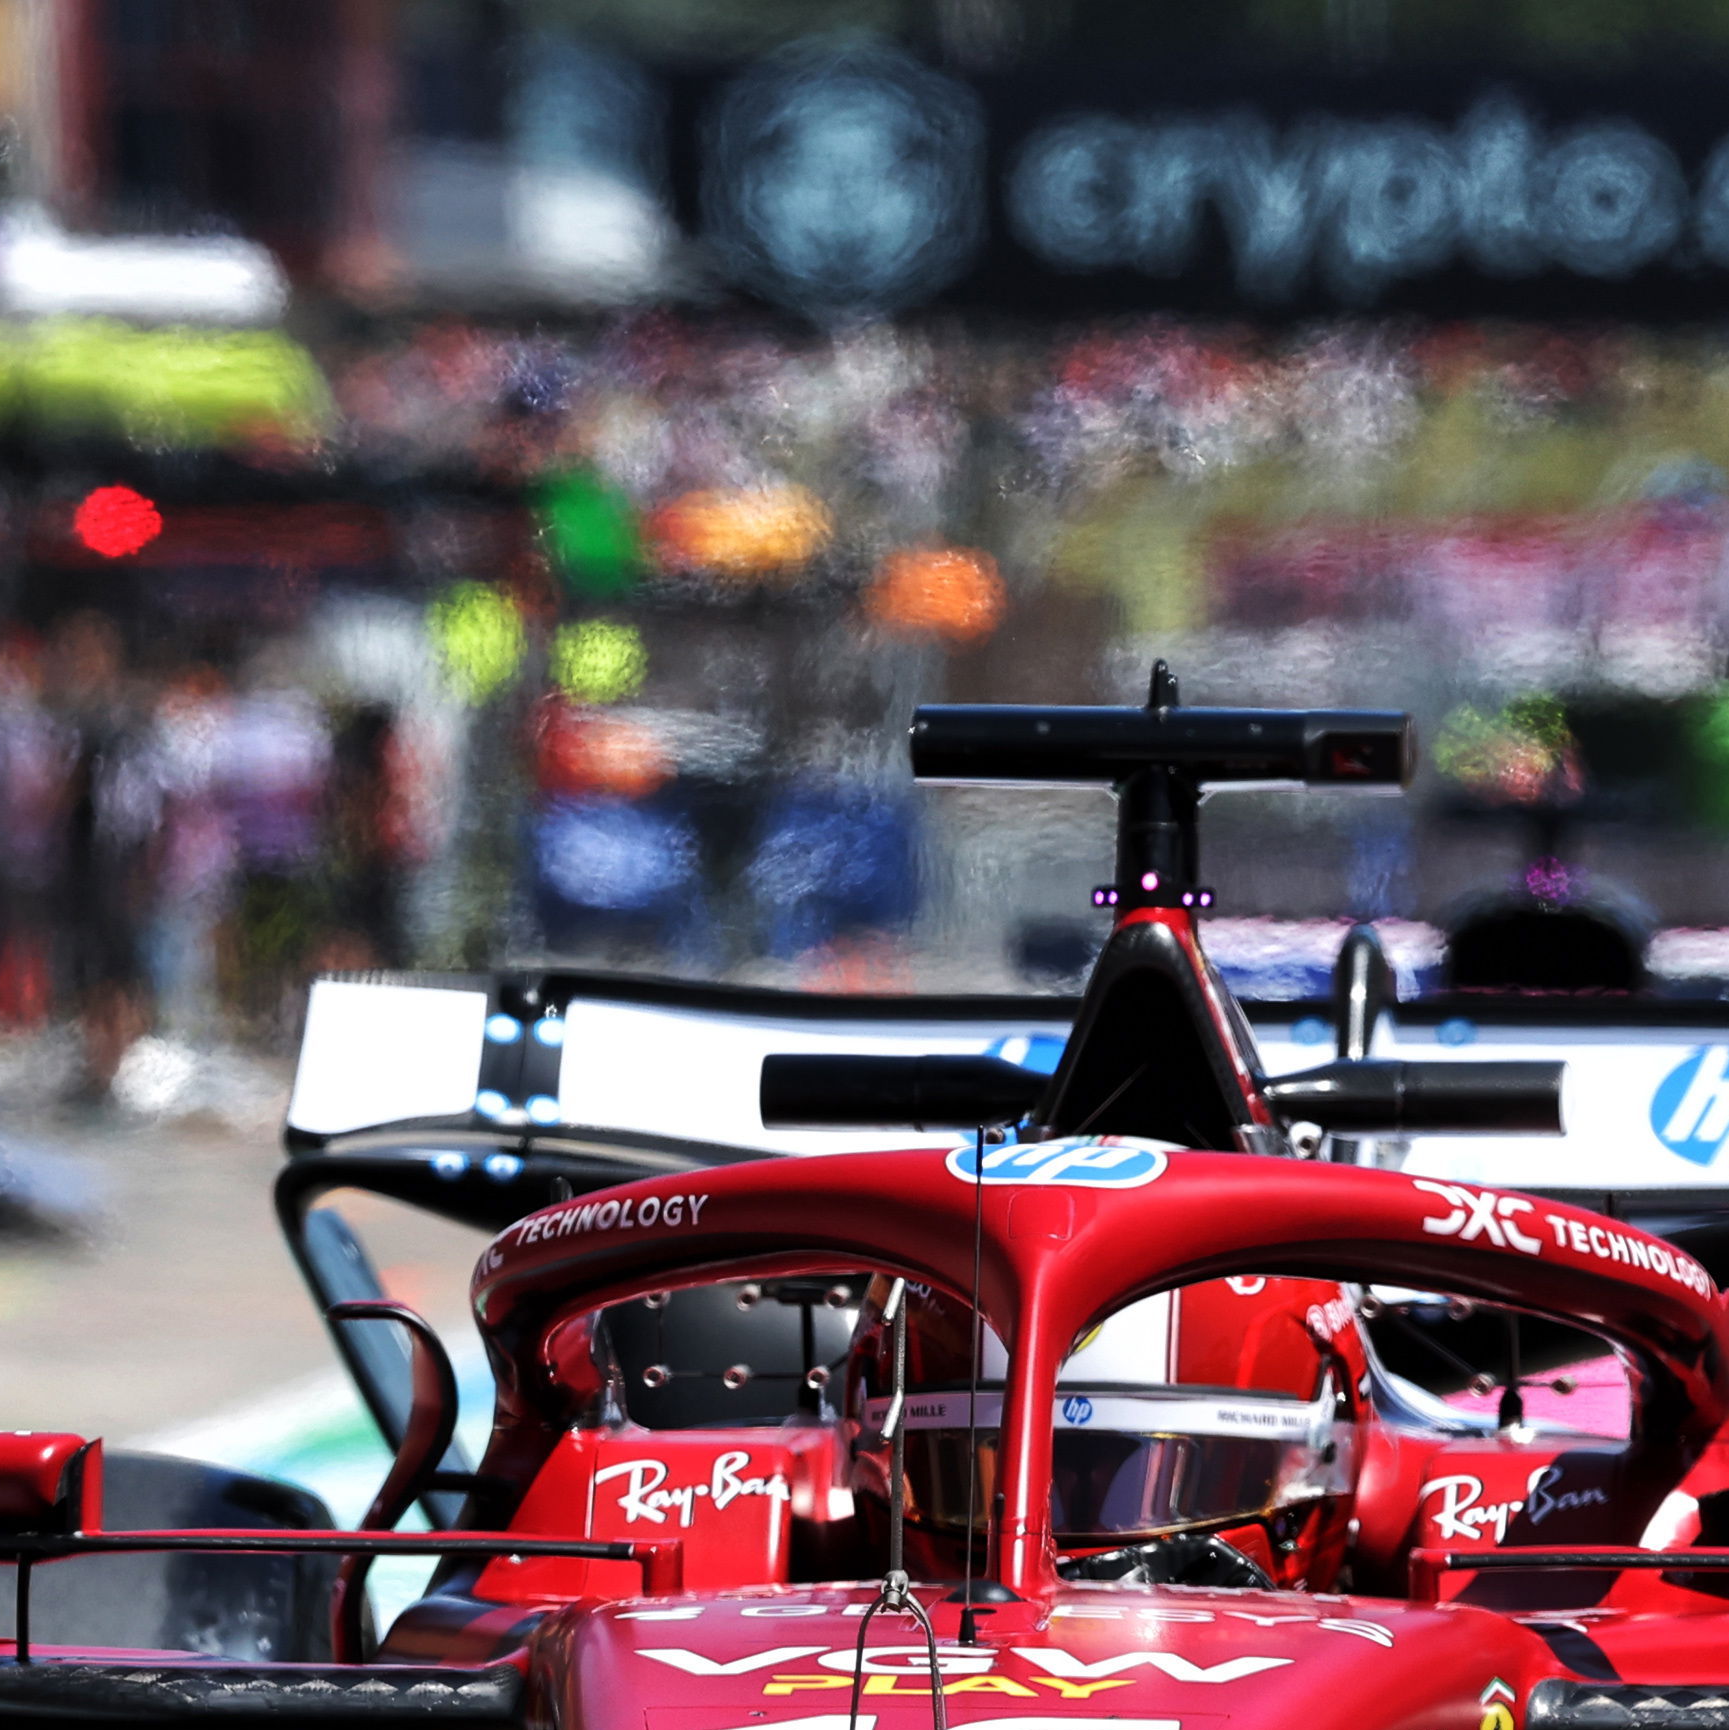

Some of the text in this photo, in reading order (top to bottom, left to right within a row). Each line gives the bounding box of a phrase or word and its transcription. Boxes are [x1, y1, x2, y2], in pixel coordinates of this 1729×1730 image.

[515, 1194, 709, 1247] TECHNOLOGY
[1413, 1179, 1712, 1301] DXC TECHNOLOGY
[1065, 1396, 1093, 1424] hp
[740, 1601, 1395, 1648] GEESYS
[634, 1645, 1295, 1684] VGW
[761, 1674, 1137, 1700] PLAY
